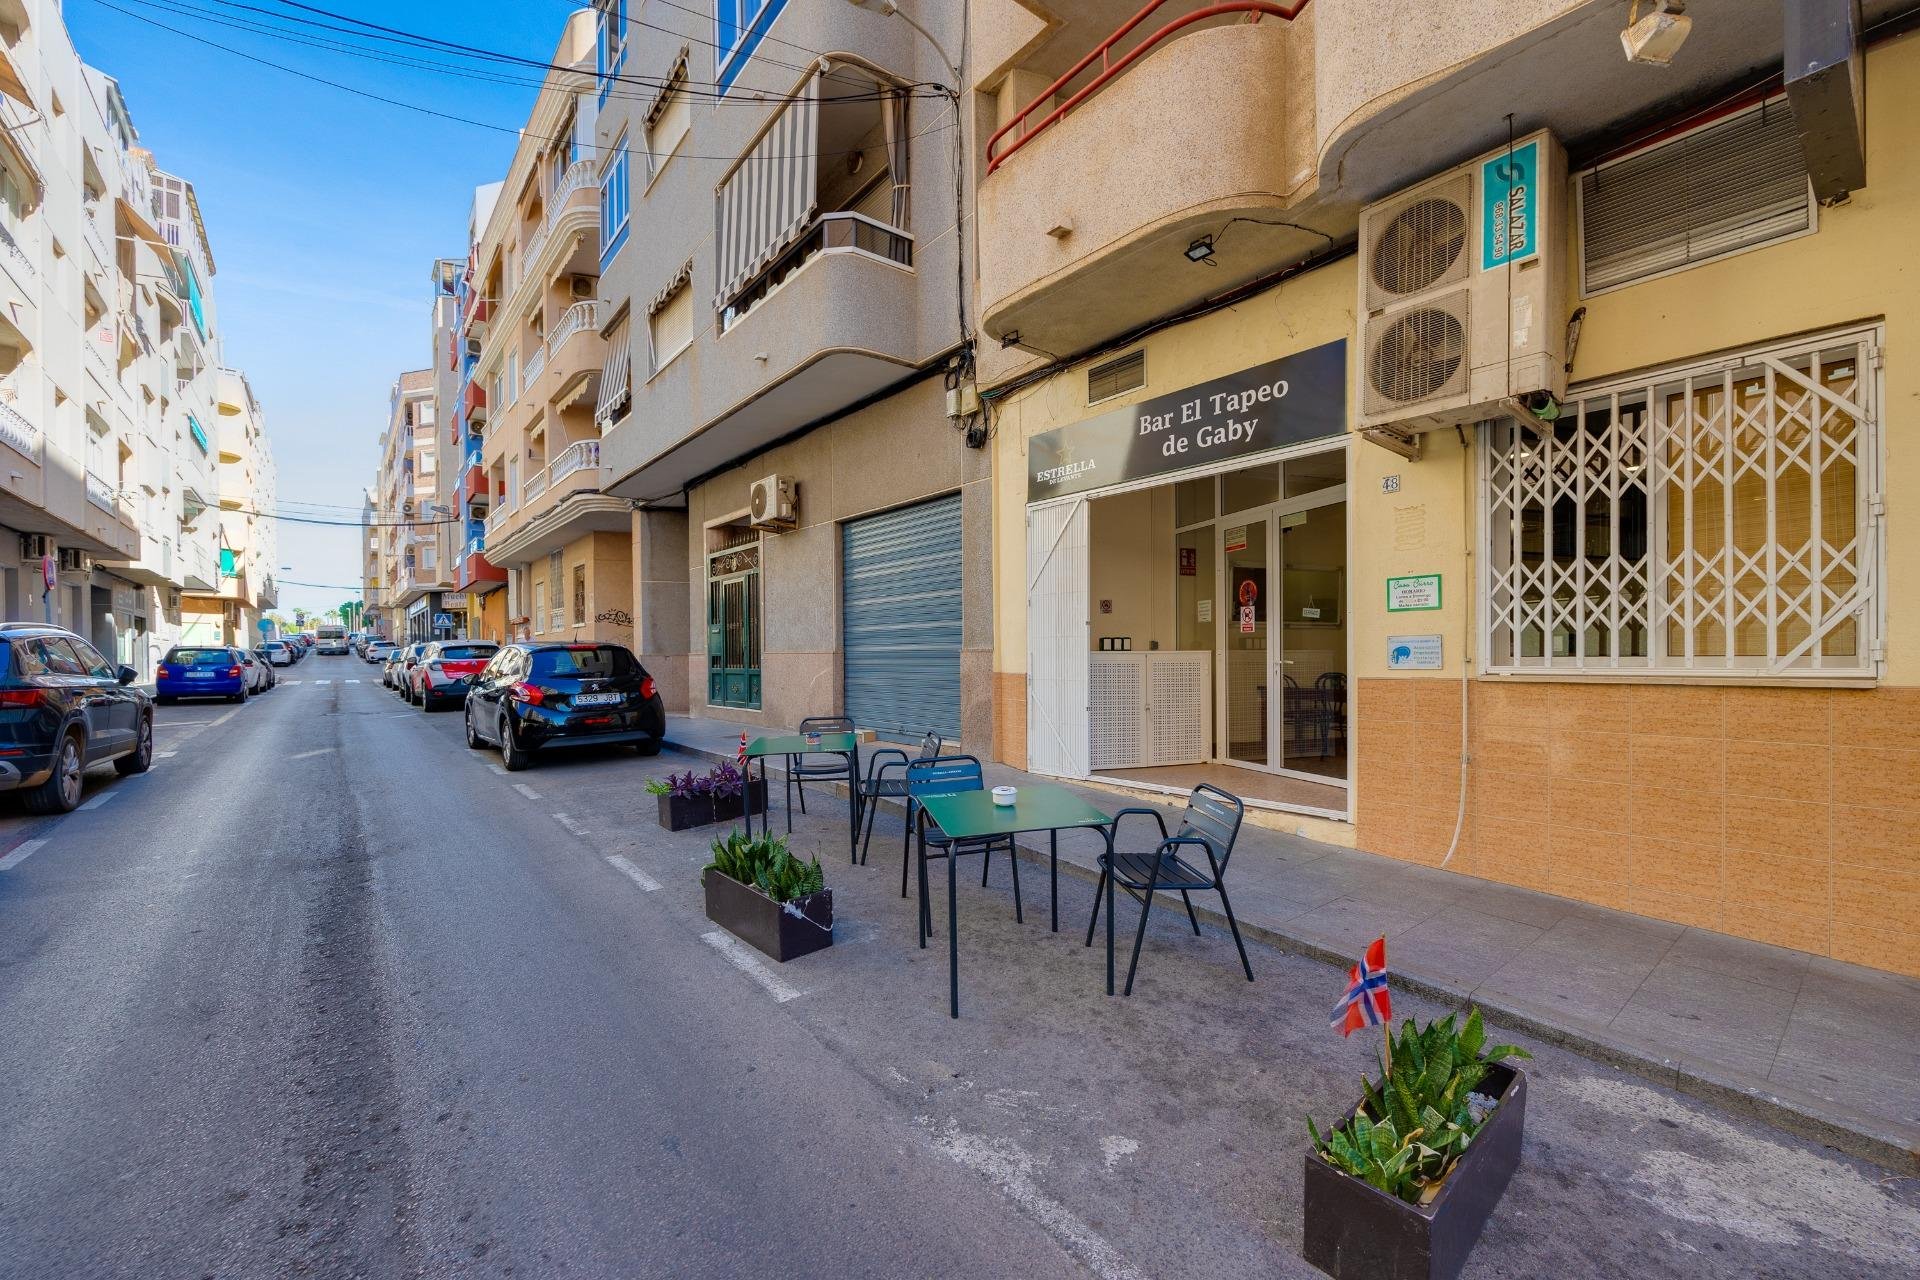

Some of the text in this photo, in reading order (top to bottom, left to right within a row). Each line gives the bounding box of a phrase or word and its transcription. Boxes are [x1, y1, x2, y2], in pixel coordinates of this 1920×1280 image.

[1509, 185, 1525, 254] SALAZAR
[1139, 379, 1289, 436] Bar El Tapeo
[1162, 418, 1259, 457] de Gaby
[1036, 458, 1096, 483] ESTRELLA
[1382, 477, 1398, 490] 48
